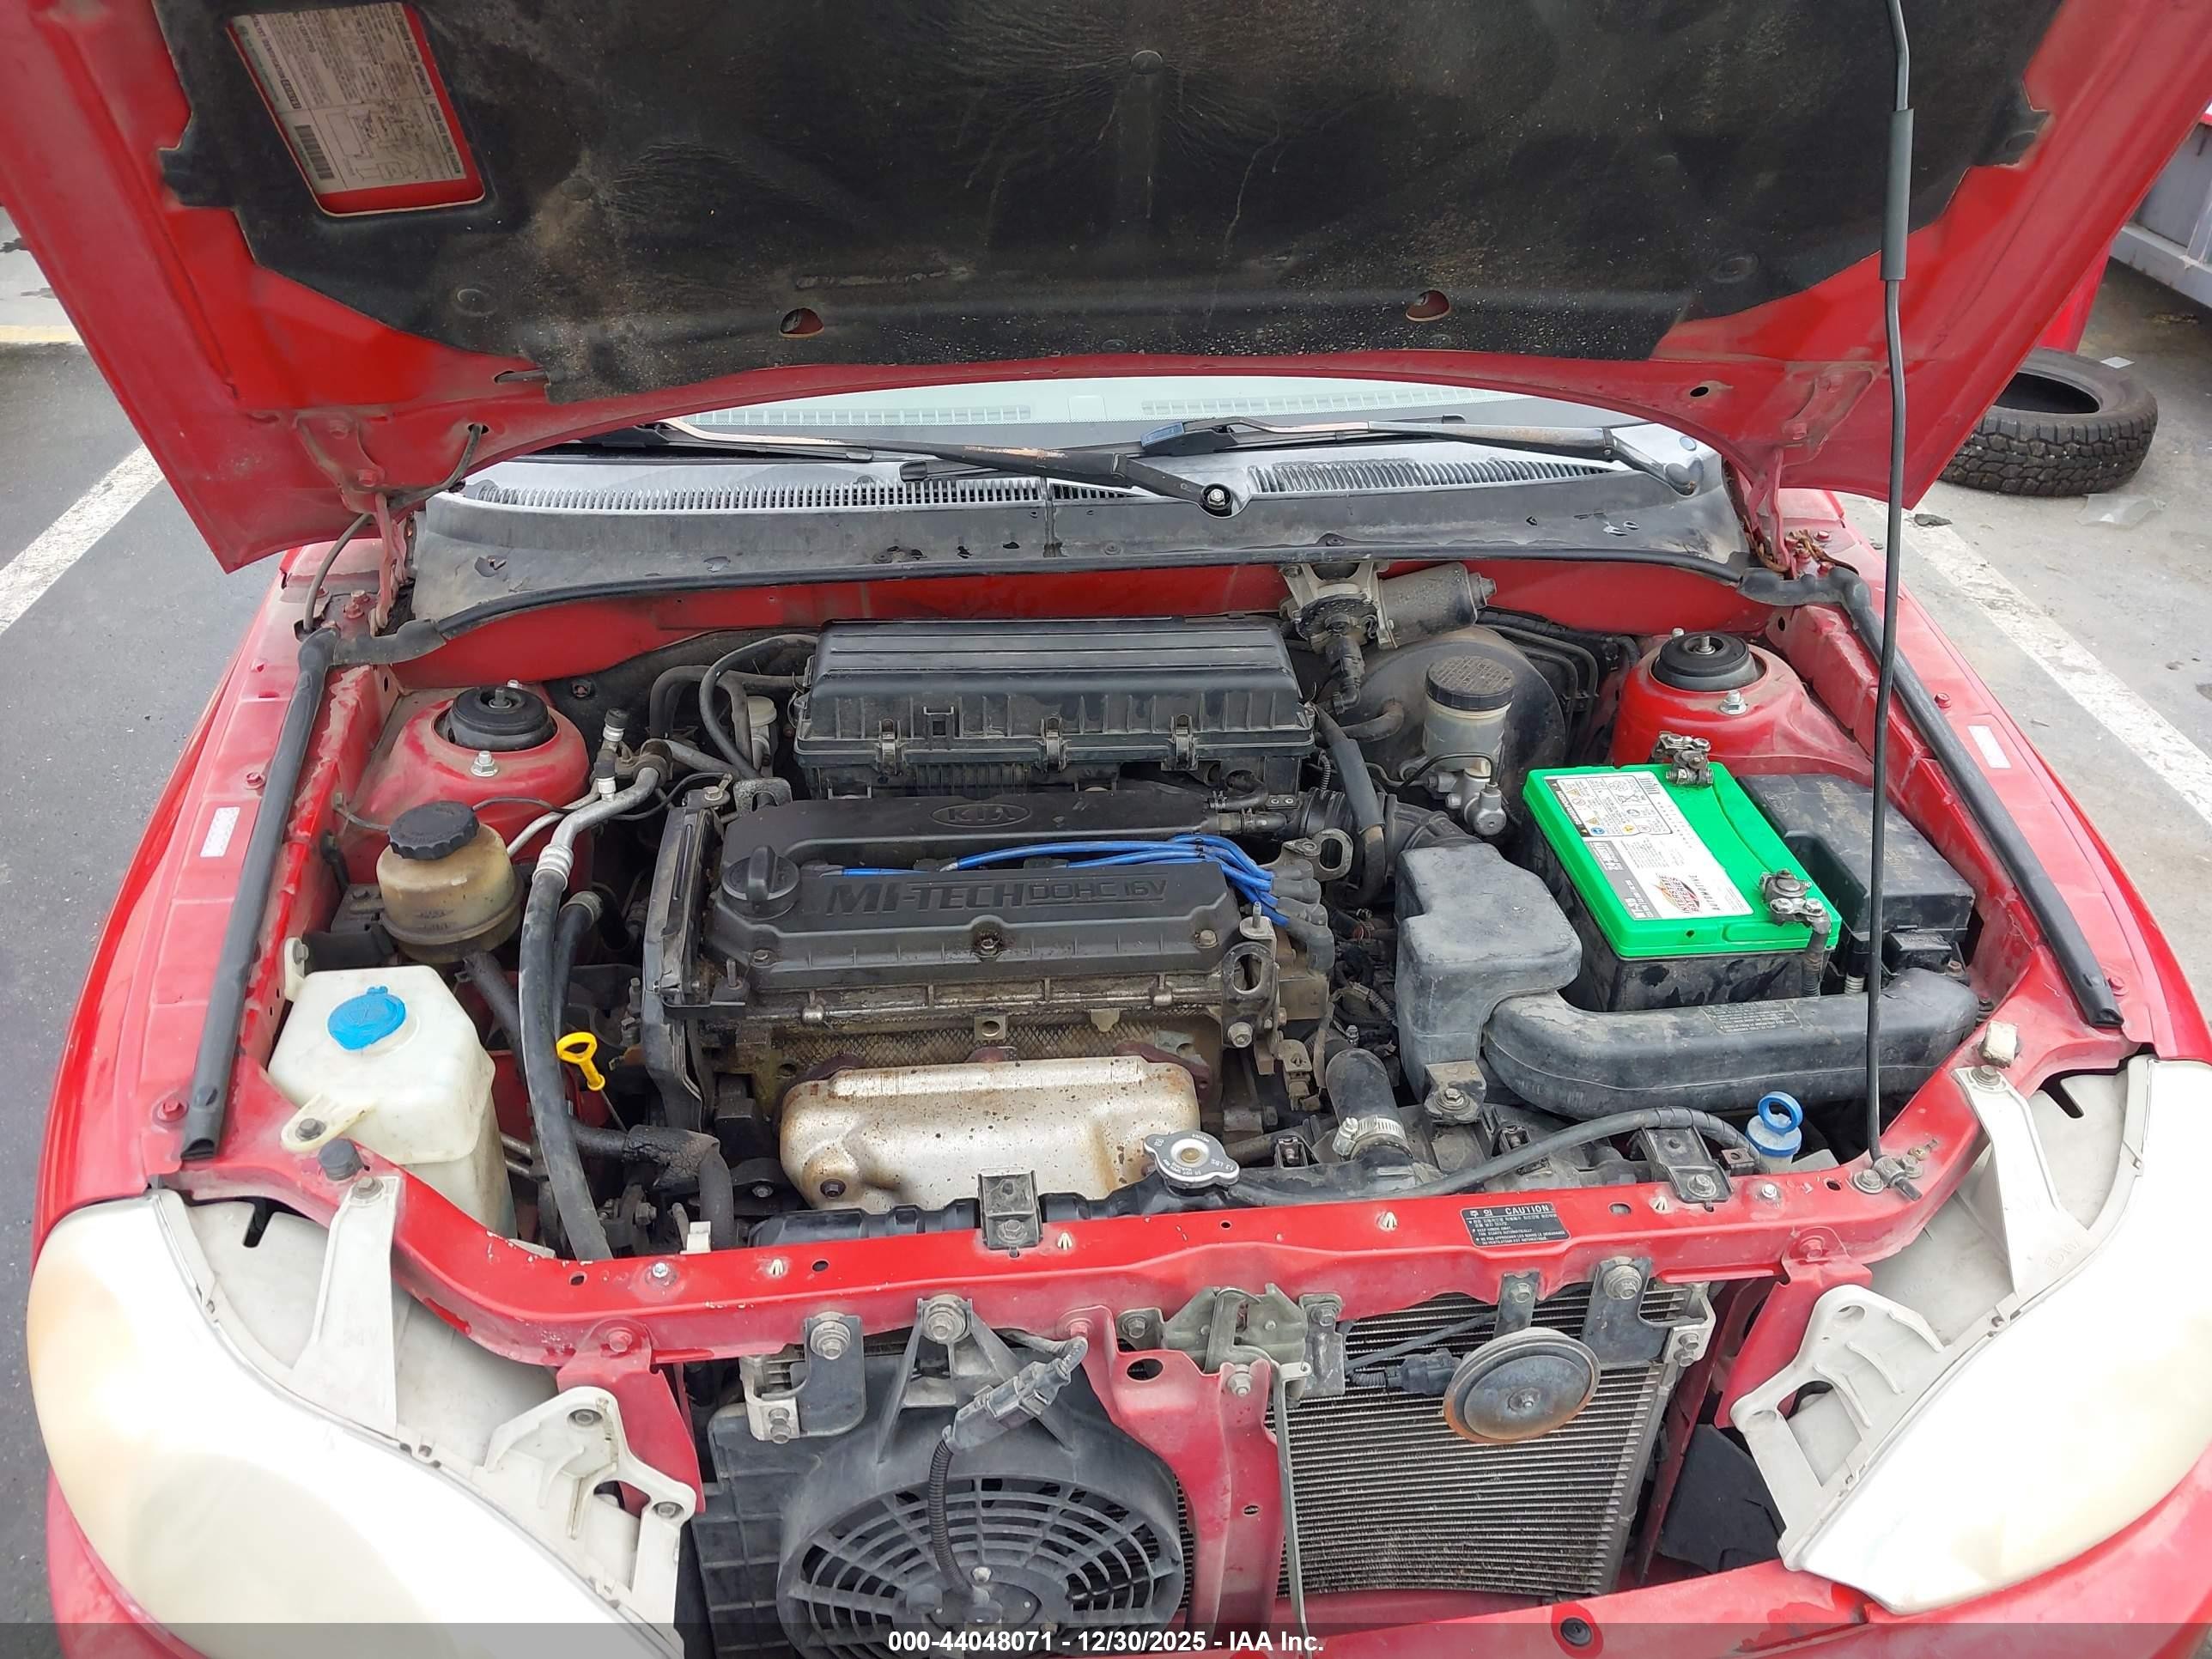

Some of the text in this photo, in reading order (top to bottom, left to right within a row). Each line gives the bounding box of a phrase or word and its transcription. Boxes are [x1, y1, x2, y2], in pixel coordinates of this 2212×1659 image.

[948, 806, 1016, 822] KIA
[826, 878, 1167, 916] MI-TECH DOHC 16V
[1658, 875, 1691, 914] INTERSTATE
[1668, 876, 1699, 911] BATTERIES
[1690, 874, 1721, 910] AUTOMOTIVE
[1505, 1205, 1549, 1215] CAUTION
